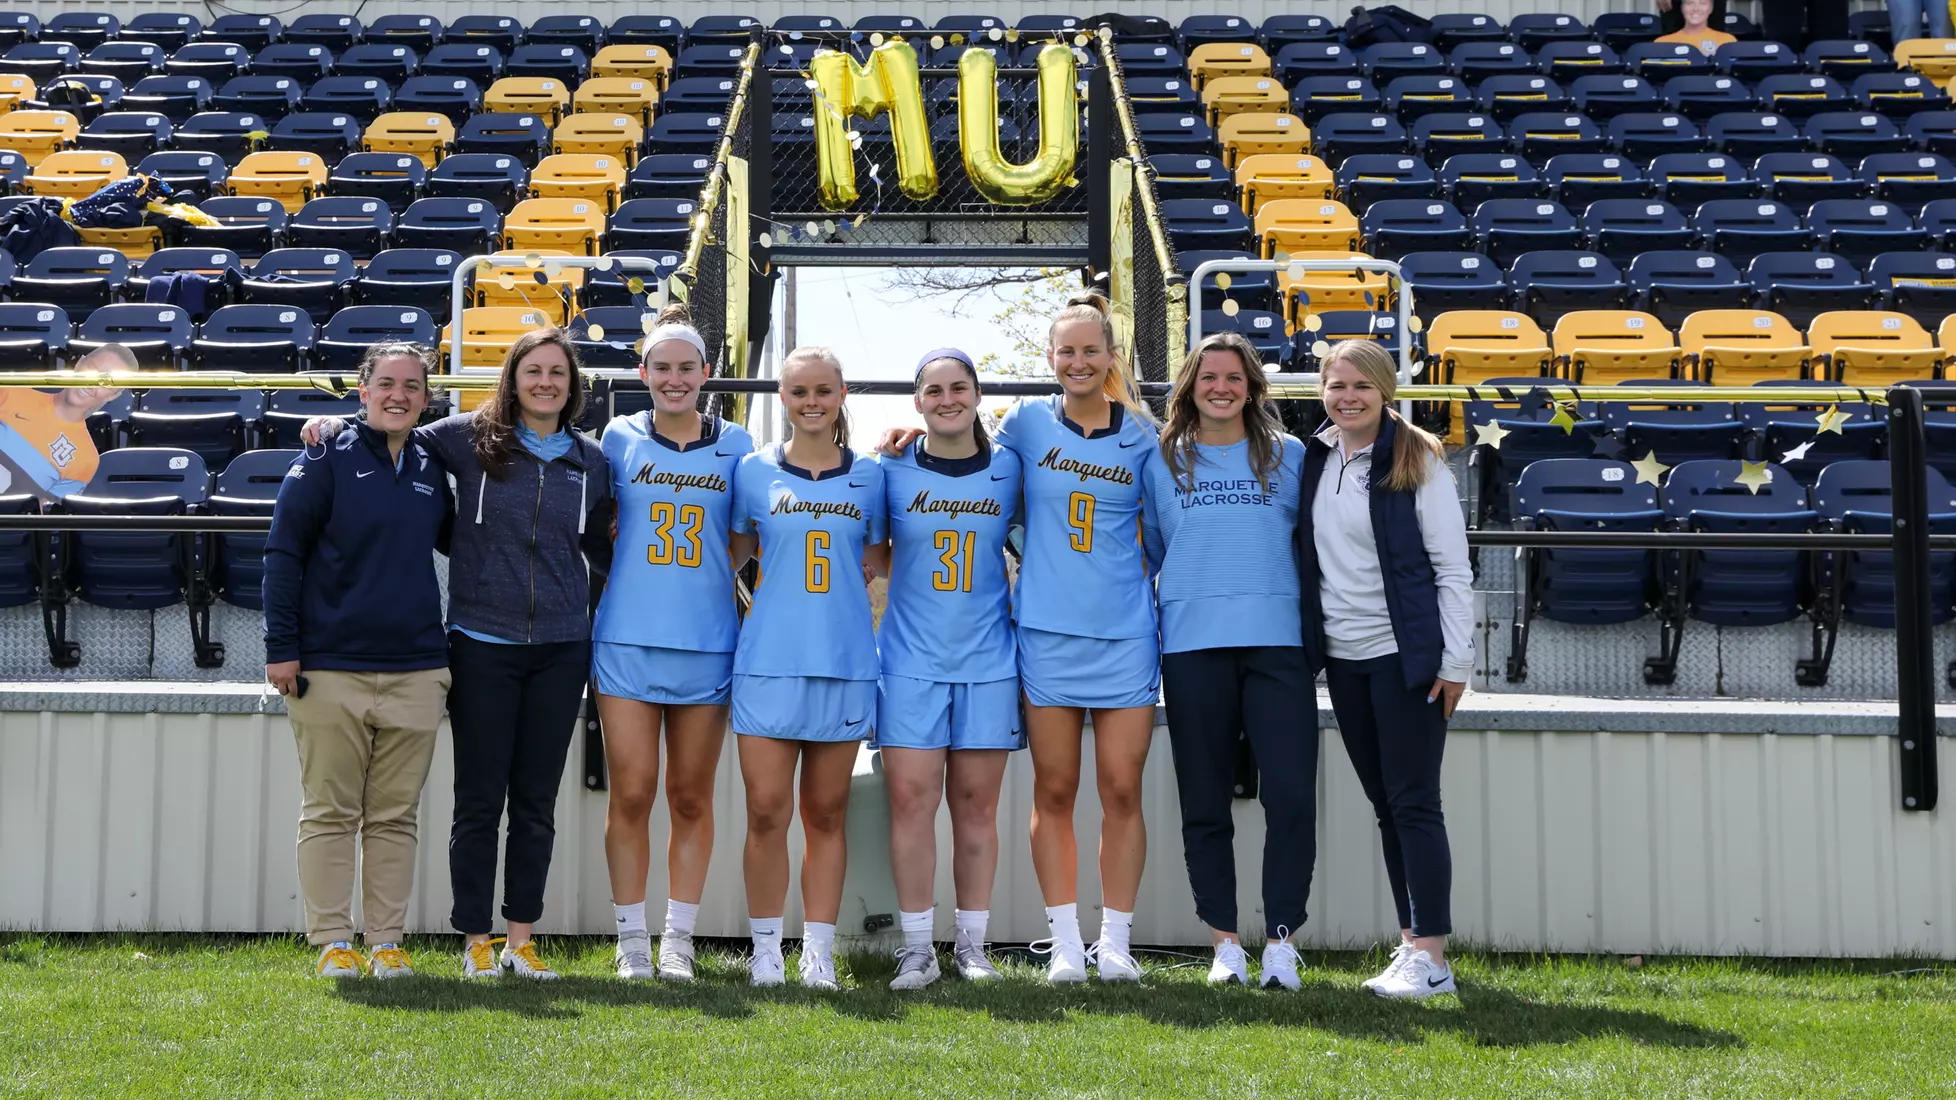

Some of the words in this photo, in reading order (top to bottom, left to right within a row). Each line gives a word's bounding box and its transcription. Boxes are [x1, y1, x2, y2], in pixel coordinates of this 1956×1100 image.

[810, 36, 1079, 211] MU
[42, 312, 49, 320] 6
[164, 312, 170, 320] 7
[284, 313, 291, 321] 8
[406, 313, 412, 322] 9
[524, 315, 534, 323] 10
[1257, 318, 1268, 327] 16
[1380, 318, 1391, 327] 17
[1505, 319, 1516, 327] 18
[1629, 319, 1641, 327] 19
[1757, 318, 1768, 327] 20
[1886, 319, 1898, 328] 21
[49, 432, 76, 468] MU
[175, 458, 183, 468] 8
[1037, 446, 1134, 486] Marquette
[631, 462, 727, 493] Marquette
[1606, 469, 1620, 479] 18
[1174, 479, 1279, 499] MARQUETE
[906, 490, 1001, 520] Marquette
[1181, 493, 1273, 509] LACROSSE
[770, 493, 862, 521] Marquette
[1068, 490, 1096, 554] 9
[647, 501, 705, 568] 33
[805, 529, 831, 594] 6
[932, 529, 976, 593] 31
